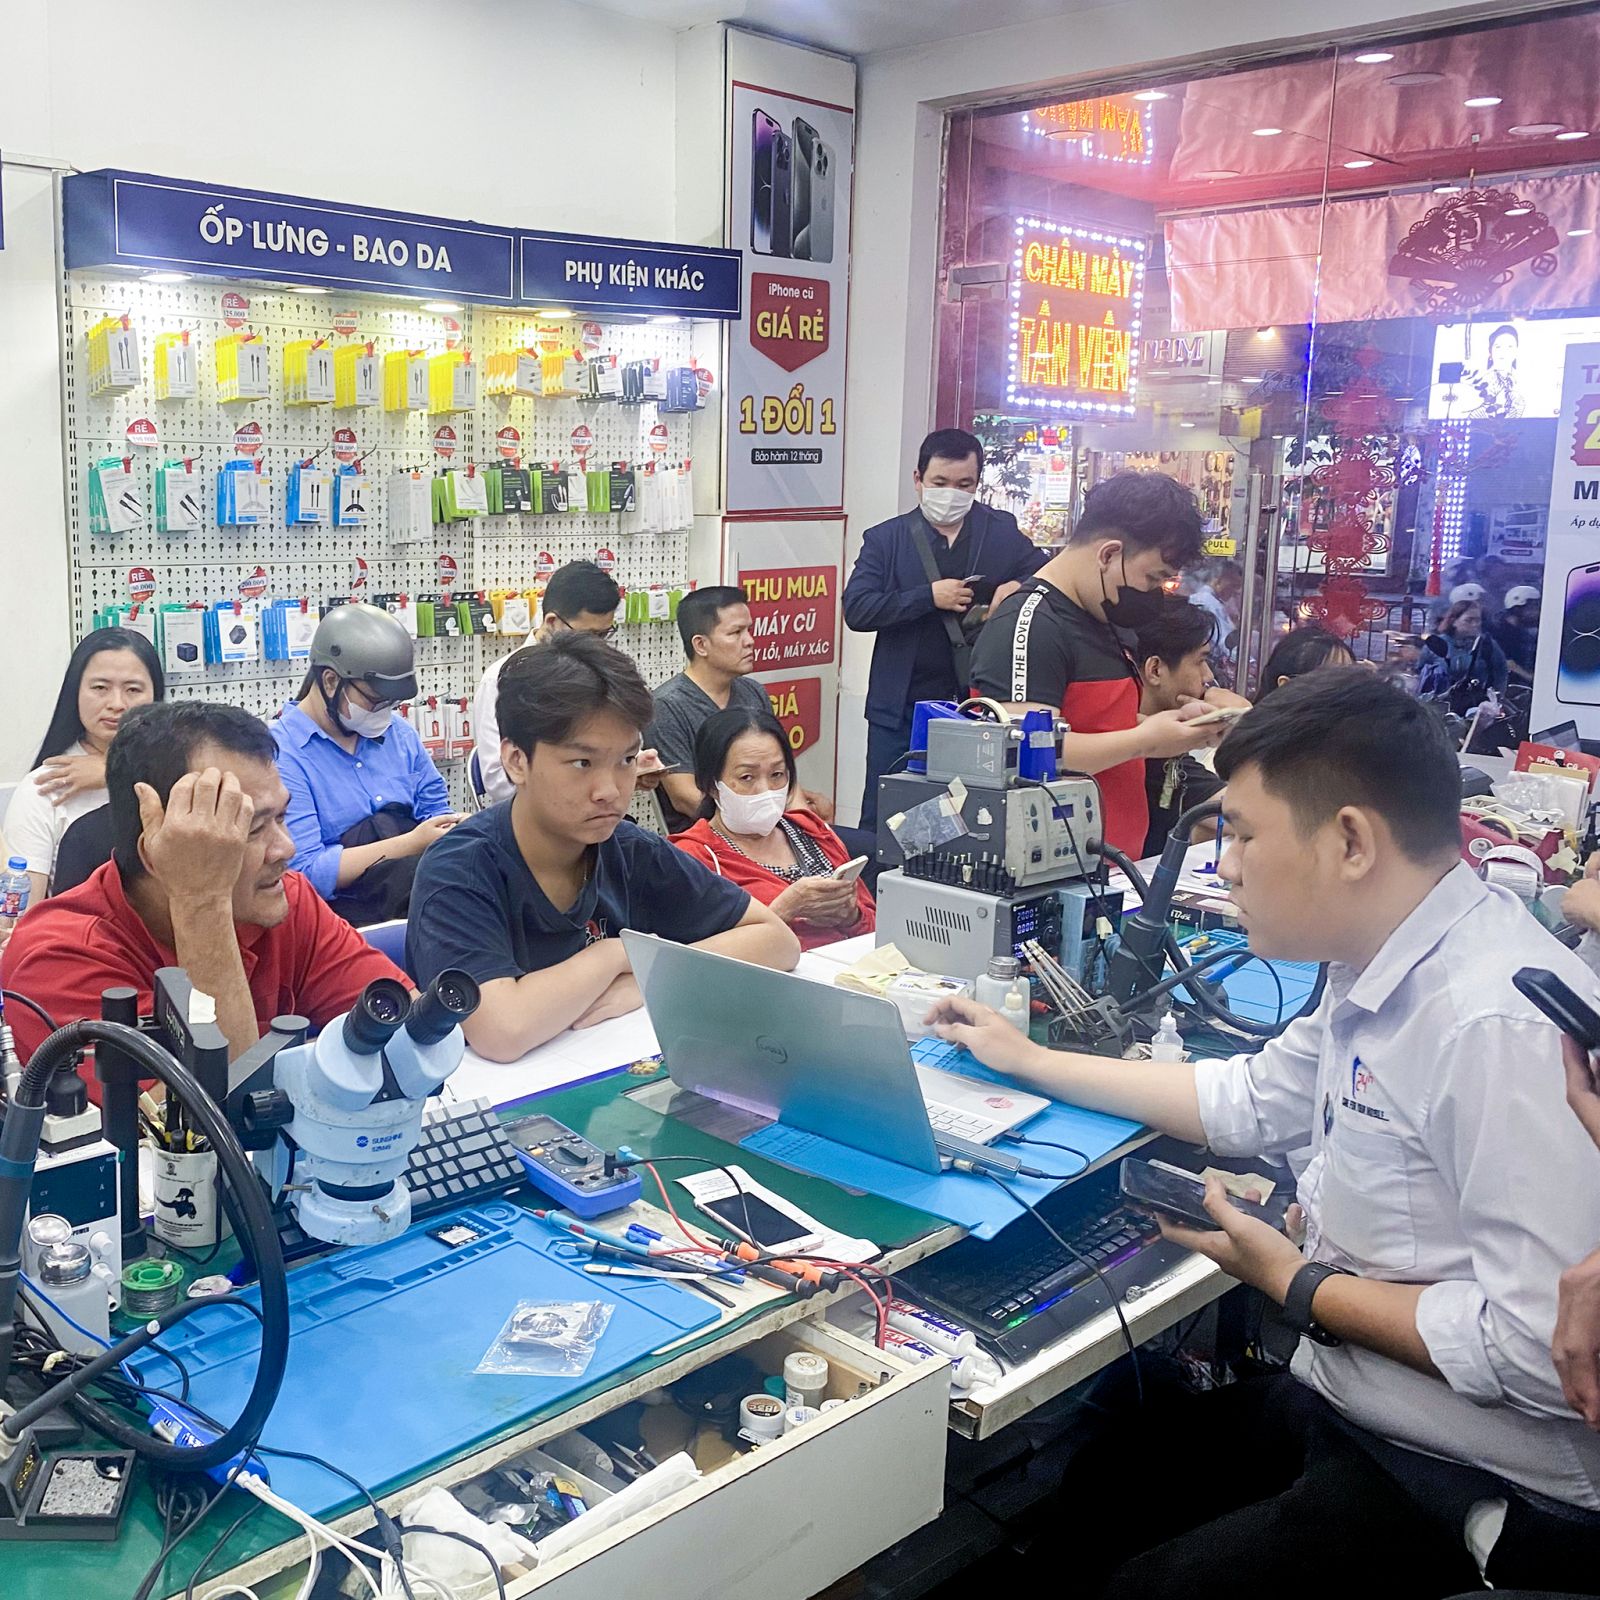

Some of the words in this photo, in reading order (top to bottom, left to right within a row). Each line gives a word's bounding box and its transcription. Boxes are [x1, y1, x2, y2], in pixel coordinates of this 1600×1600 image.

[200, 203, 243, 246] ỐP
[253, 220, 329, 257] LƯNG
[353, 234, 409, 267] BAO
[417, 242, 452, 273] DA
[565, 260, 603, 290] PHỤ
[609, 259, 649, 292] KIỆN
[654, 264, 705, 291] KHÁC
[1025, 237, 1087, 290] CHÂN
[768, 282, 800, 299] iPhone
[802, 287, 814, 299] cũ
[756, 304, 794, 340] GIÁ
[799, 308, 825, 342] RẺ
[1020, 299, 1072, 386] TÂN
[1078, 310, 1132, 392] VIÊN
[739, 395, 758, 435] 1
[761, 383, 814, 435] ĐỔI
[820, 398, 837, 435] 1
[755, 450, 770, 461] Bảo
[770, 451, 788, 461] hành
[790, 451, 798, 461] 12
[799, 451, 819, 463] tháng
[1570, 515, 1586, 528] Áp
[1207, 540, 1230, 549] PULL
[131, 569, 146, 581] RẺ
[742, 576, 783, 602] THU
[786, 574, 828, 599] MUA
[753, 610, 791, 638] MÁY
[793, 607, 817, 633] CŨ
[1016, 620, 1029, 651] LOVE
[762, 640, 781, 662] LỖI,
[784, 641, 807, 658] MÁY
[807, 638, 830, 656] XÁC
[1015, 655, 1025, 679] THE
